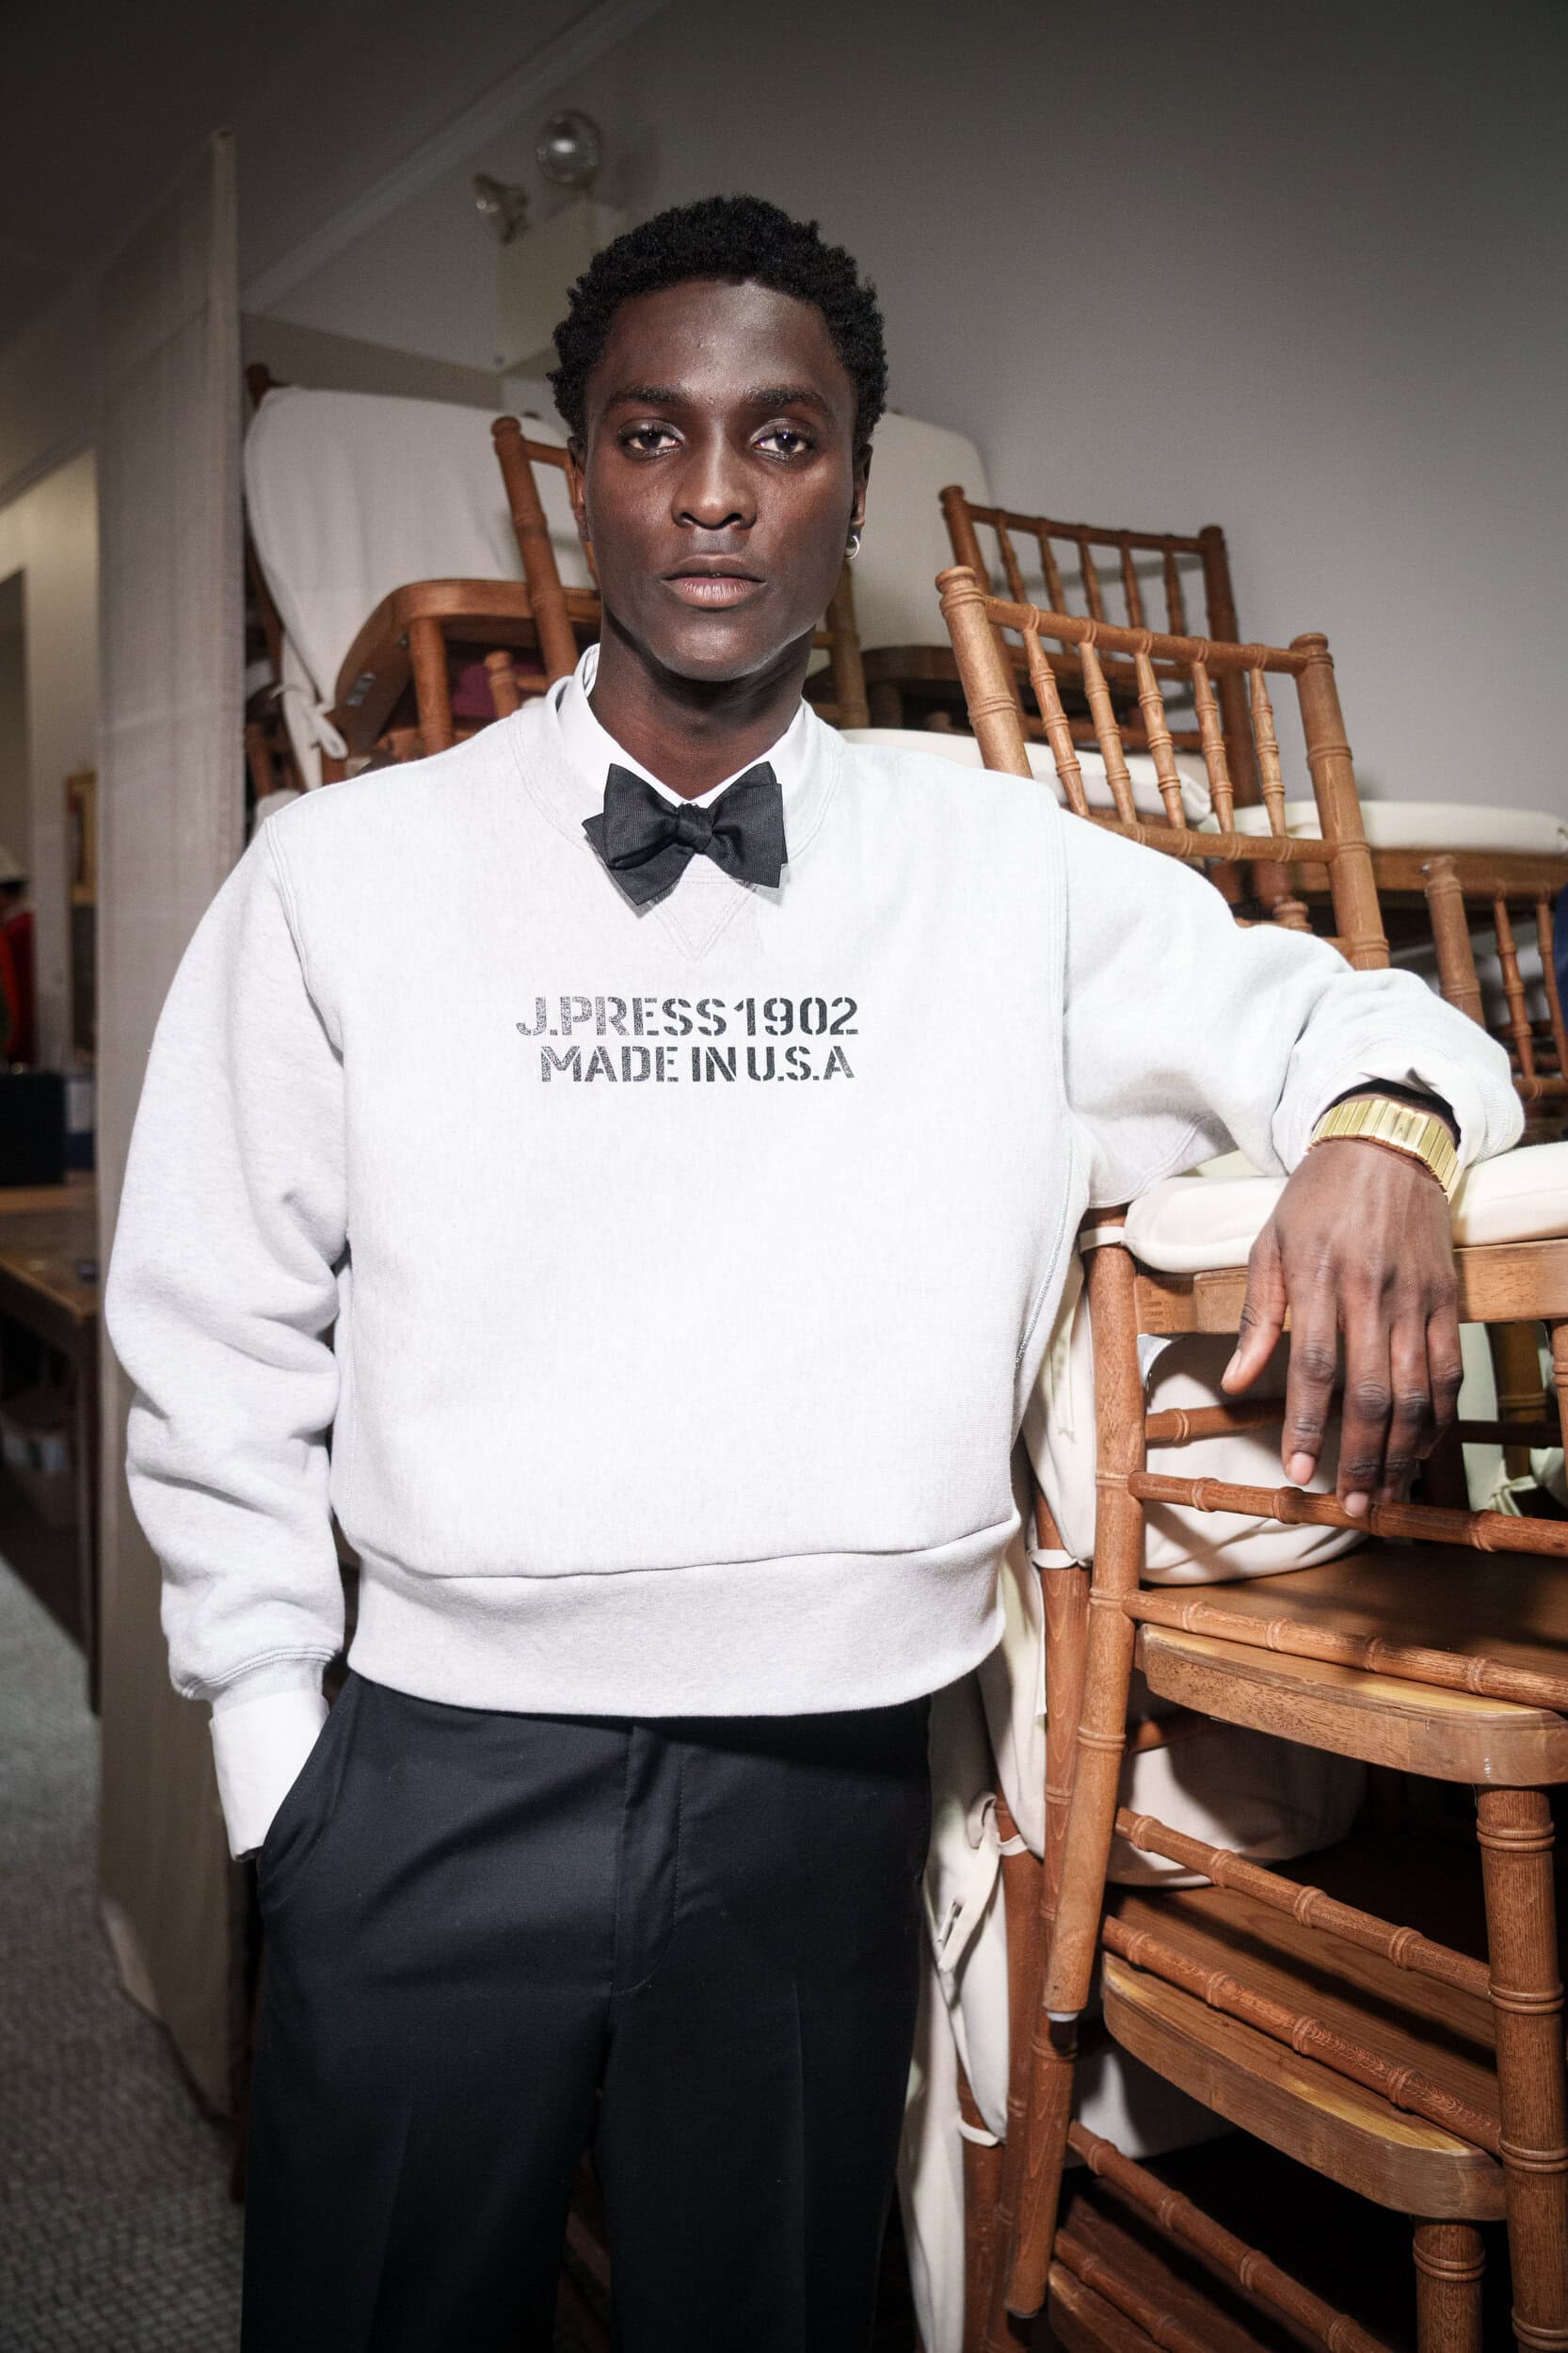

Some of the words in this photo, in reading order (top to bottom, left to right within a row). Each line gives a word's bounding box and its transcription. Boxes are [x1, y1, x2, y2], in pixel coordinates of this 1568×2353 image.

[733, 997, 859, 1036] 1902
[541, 1045, 680, 1082] MADE
[691, 1046, 737, 1082] IN
[746, 1045, 856, 1082] U.S.A
